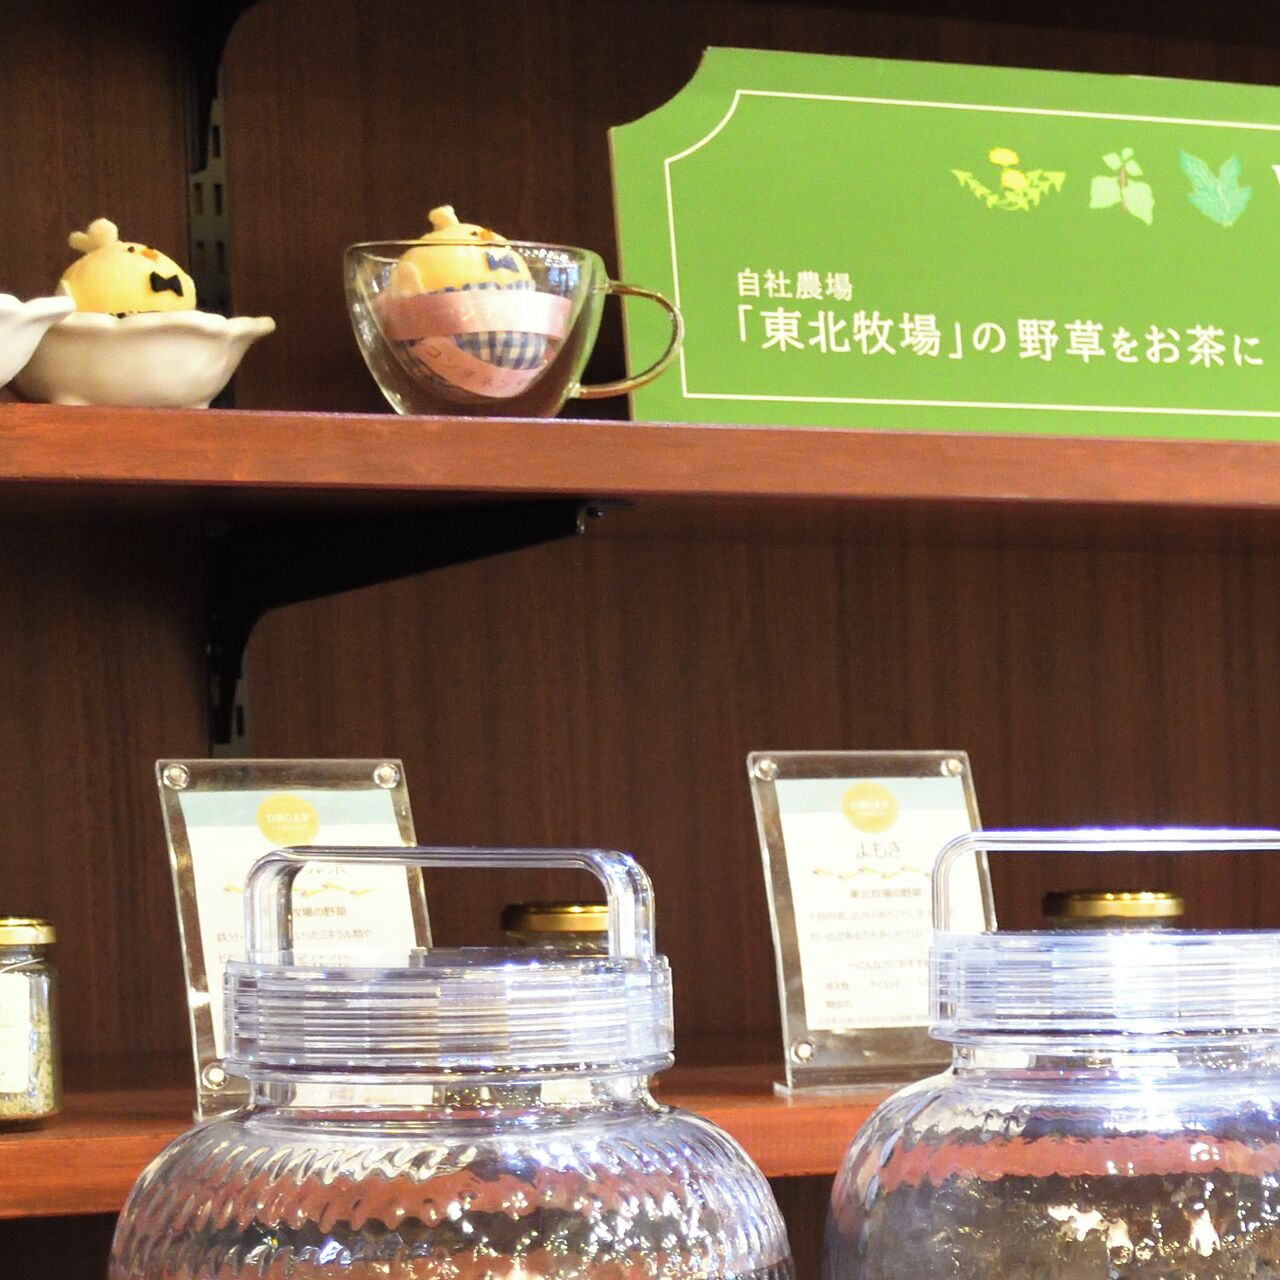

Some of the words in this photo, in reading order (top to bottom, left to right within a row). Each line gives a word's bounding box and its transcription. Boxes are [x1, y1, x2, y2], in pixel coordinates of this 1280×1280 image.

[737, 267, 853, 301] 自社農場
[737, 304, 1264, 368] 「東北牧場」の野草をお茶に
